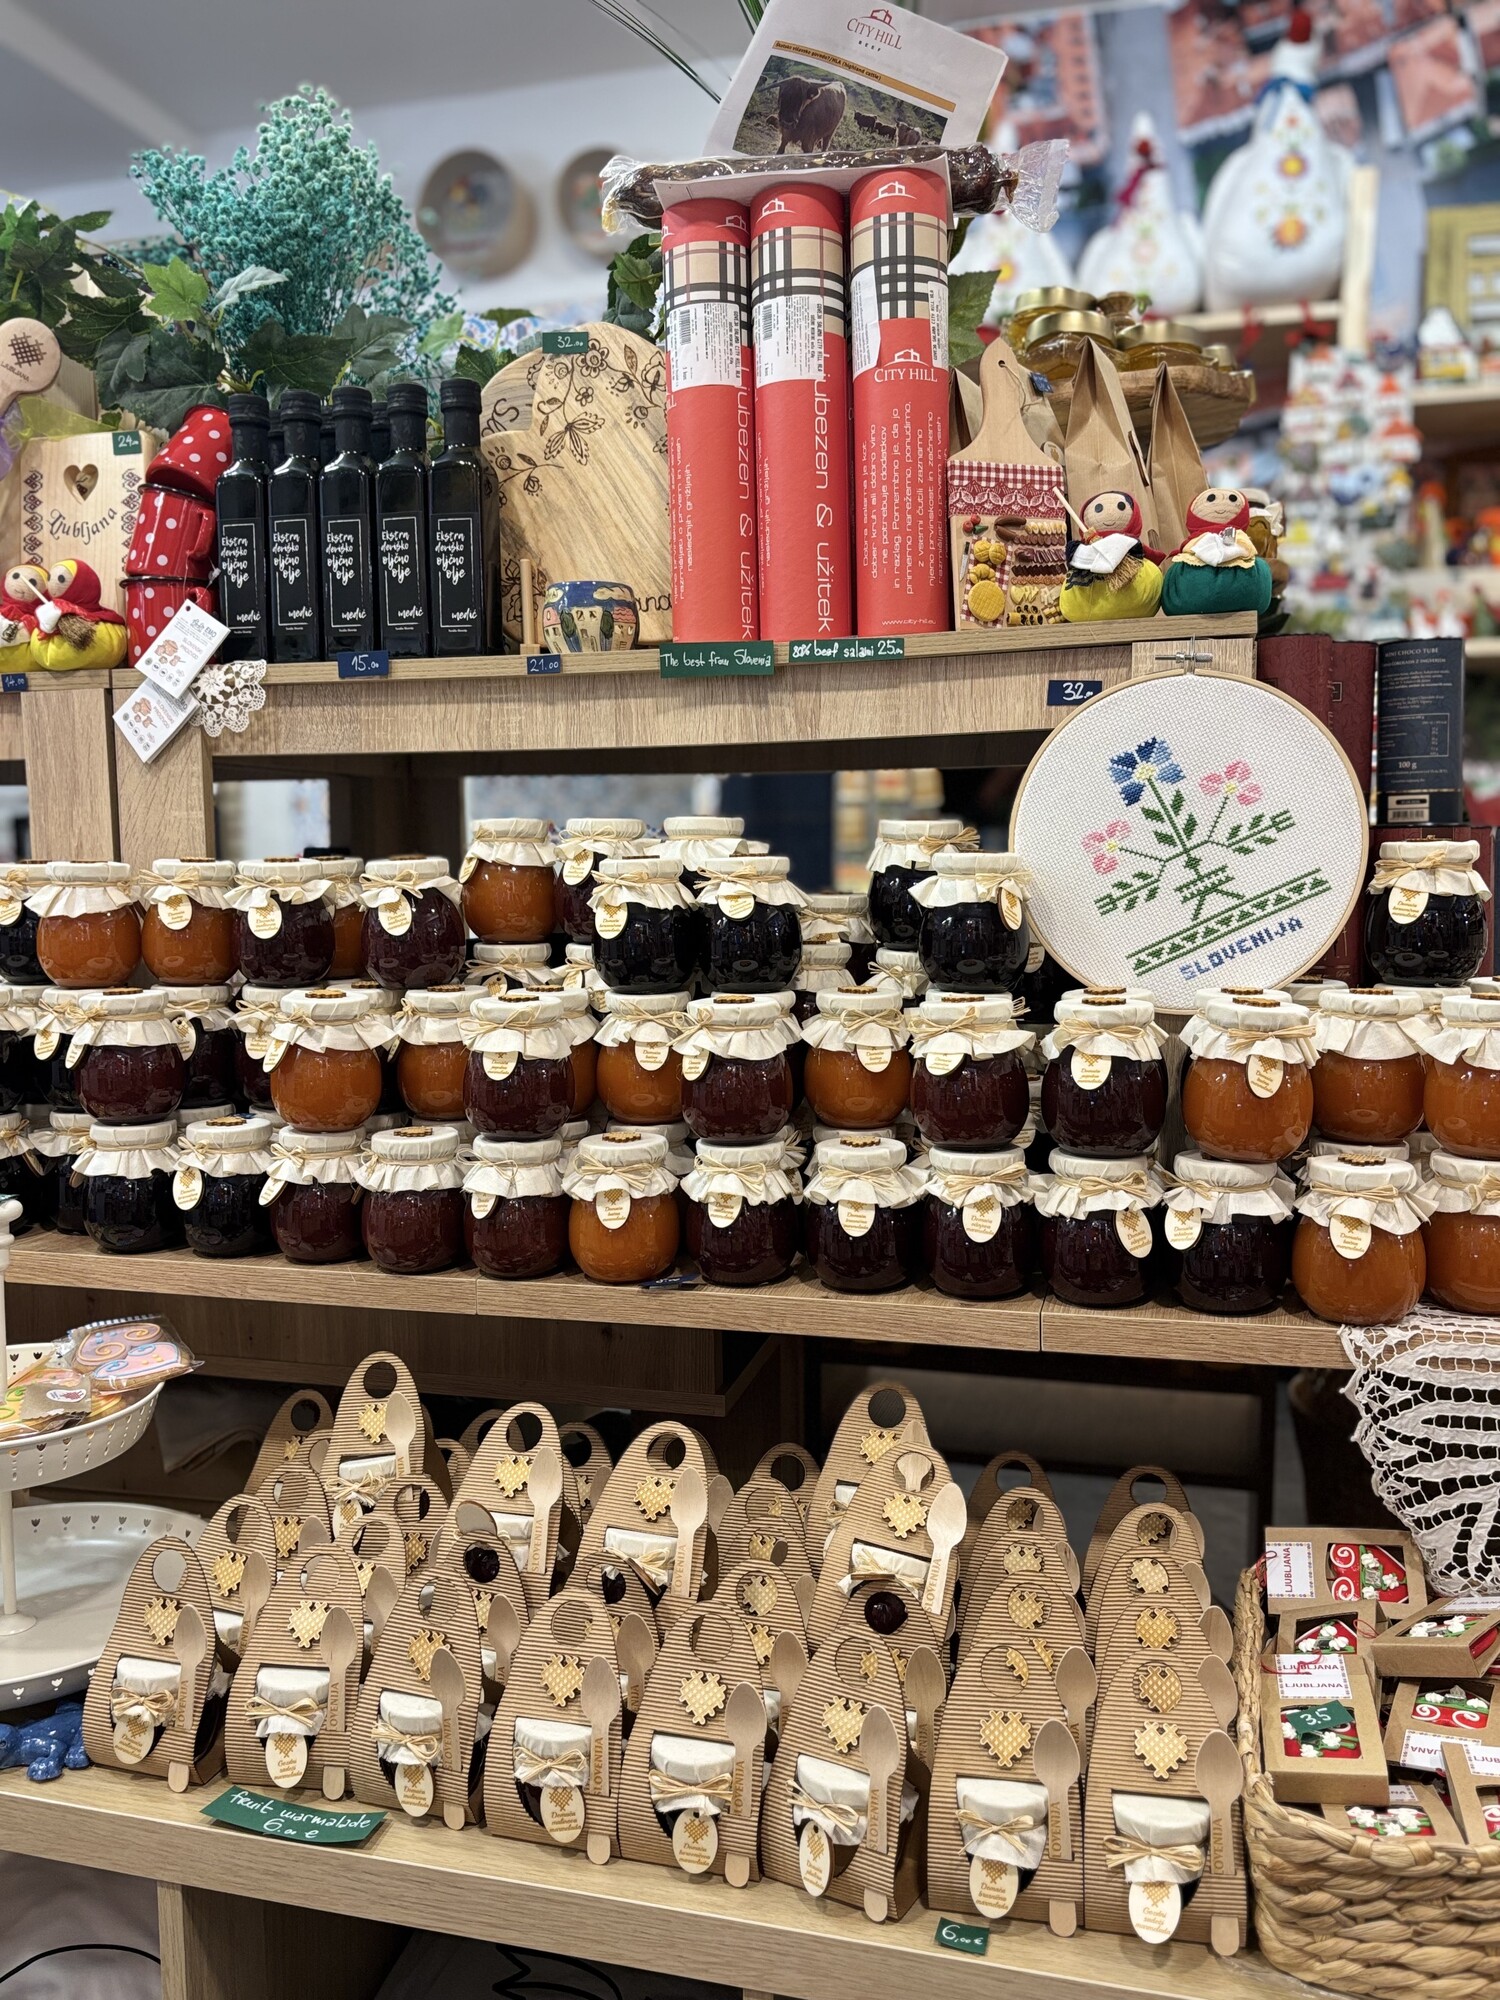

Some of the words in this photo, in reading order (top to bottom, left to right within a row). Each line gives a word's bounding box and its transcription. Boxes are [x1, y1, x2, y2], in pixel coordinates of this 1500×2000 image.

[846, 18, 875, 38] CITY
[874, 28, 902, 50] HILL
[874, 368, 906, 383] CITY
[910, 368, 938, 382] HILL
[892, 408, 901, 419] jo
[892, 424, 901, 438] da
[927, 412, 936, 467] začnemo
[880, 426, 889, 480] dodatkov
[916, 429, 924, 483] zaznamo
[863, 465, 868, 475] je
[927, 471, 936, 481] in
[892, 460, 901, 530] Pomembno
[916, 488, 924, 515] čutili
[816, 503, 833, 528] &
[880, 485, 889, 544] potrebuje
[927, 486, 936, 550] prvinskost
[46, 508, 118, 546] Ljubljana
[739, 513, 754, 537] &
[222, 537, 248, 547] Ekstra
[273, 532, 300, 542] Ekstra
[327, 532, 354, 542] Ekstra
[381, 530, 410, 541] Ekstra
[436, 531, 465, 541] Ekstra
[916, 520, 924, 556] vsemi
[274, 554, 300, 571] oljčno
[327, 555, 353, 572] oljčno
[382, 552, 410, 571] oljčno
[436, 554, 465, 572] oljčno
[880, 549, 889, 564] ne
[904, 535, 914, 594] primerno
[222, 558, 248, 575] oljčno
[282, 565, 302, 584] olje
[392, 564, 411, 584] olje
[446, 566, 466, 585] olje
[927, 554, 936, 586] njeno
[230, 570, 249, 588] olje
[336, 567, 355, 586] olje
[892, 578, 901, 589] in
[740, 552, 754, 640] užitek
[817, 542, 835, 633] užitek
[352, 654, 379, 671] 15.00
[530, 658, 559, 672] 21.00
[660, 652, 679, 667] The
[683, 651, 706, 667] best
[733, 649, 771, 667] Slovenia
[1179, 916, 1303, 980] SLOVENIJA
[674, 1544, 686, 1594] LOVENIJA
[1283, 1547, 1293, 1593] LJUBLJANA
[923, 1558, 942, 1612] SLOVENIJA
[177, 1680, 188, 1728] LOVENIJA
[1300, 1707, 1331, 1725] 3.5
[734, 1760, 744, 1813] LOVENIJA
[230, 1791, 274, 1814] fruit
[1051, 1802, 1062, 1858] LOVENIJA
